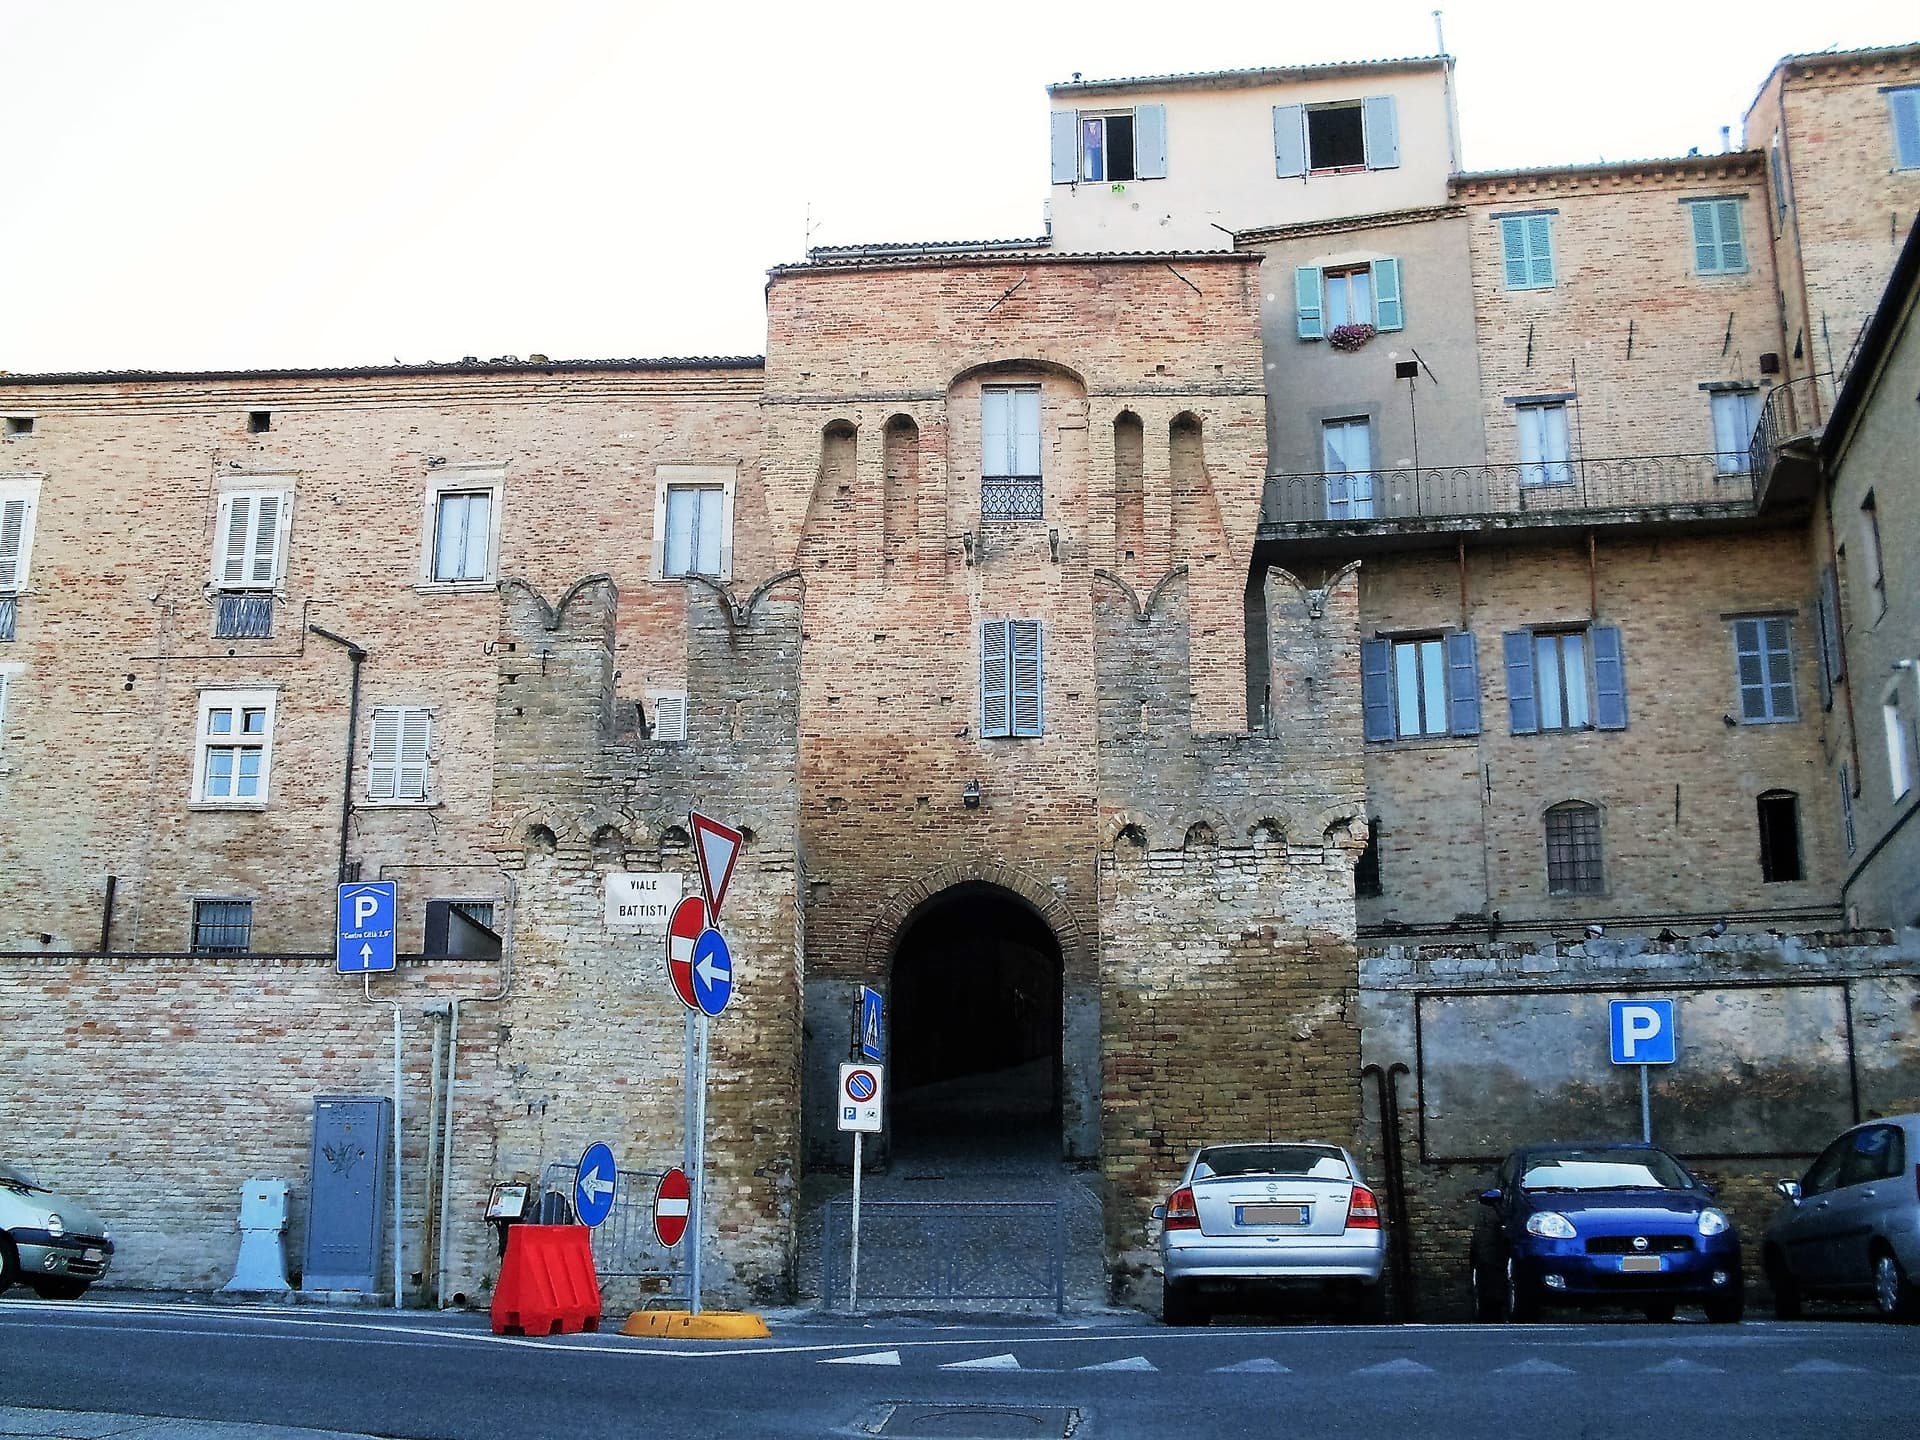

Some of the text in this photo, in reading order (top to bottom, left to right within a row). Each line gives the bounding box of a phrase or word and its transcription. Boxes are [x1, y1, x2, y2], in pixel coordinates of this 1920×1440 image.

[630, 880, 657, 890] VIALE
[355, 895, 379, 929] P
[619, 904, 667, 916] BATTISTI
[1622, 1006, 1661, 1057] P
[845, 1108, 854, 1120] P
